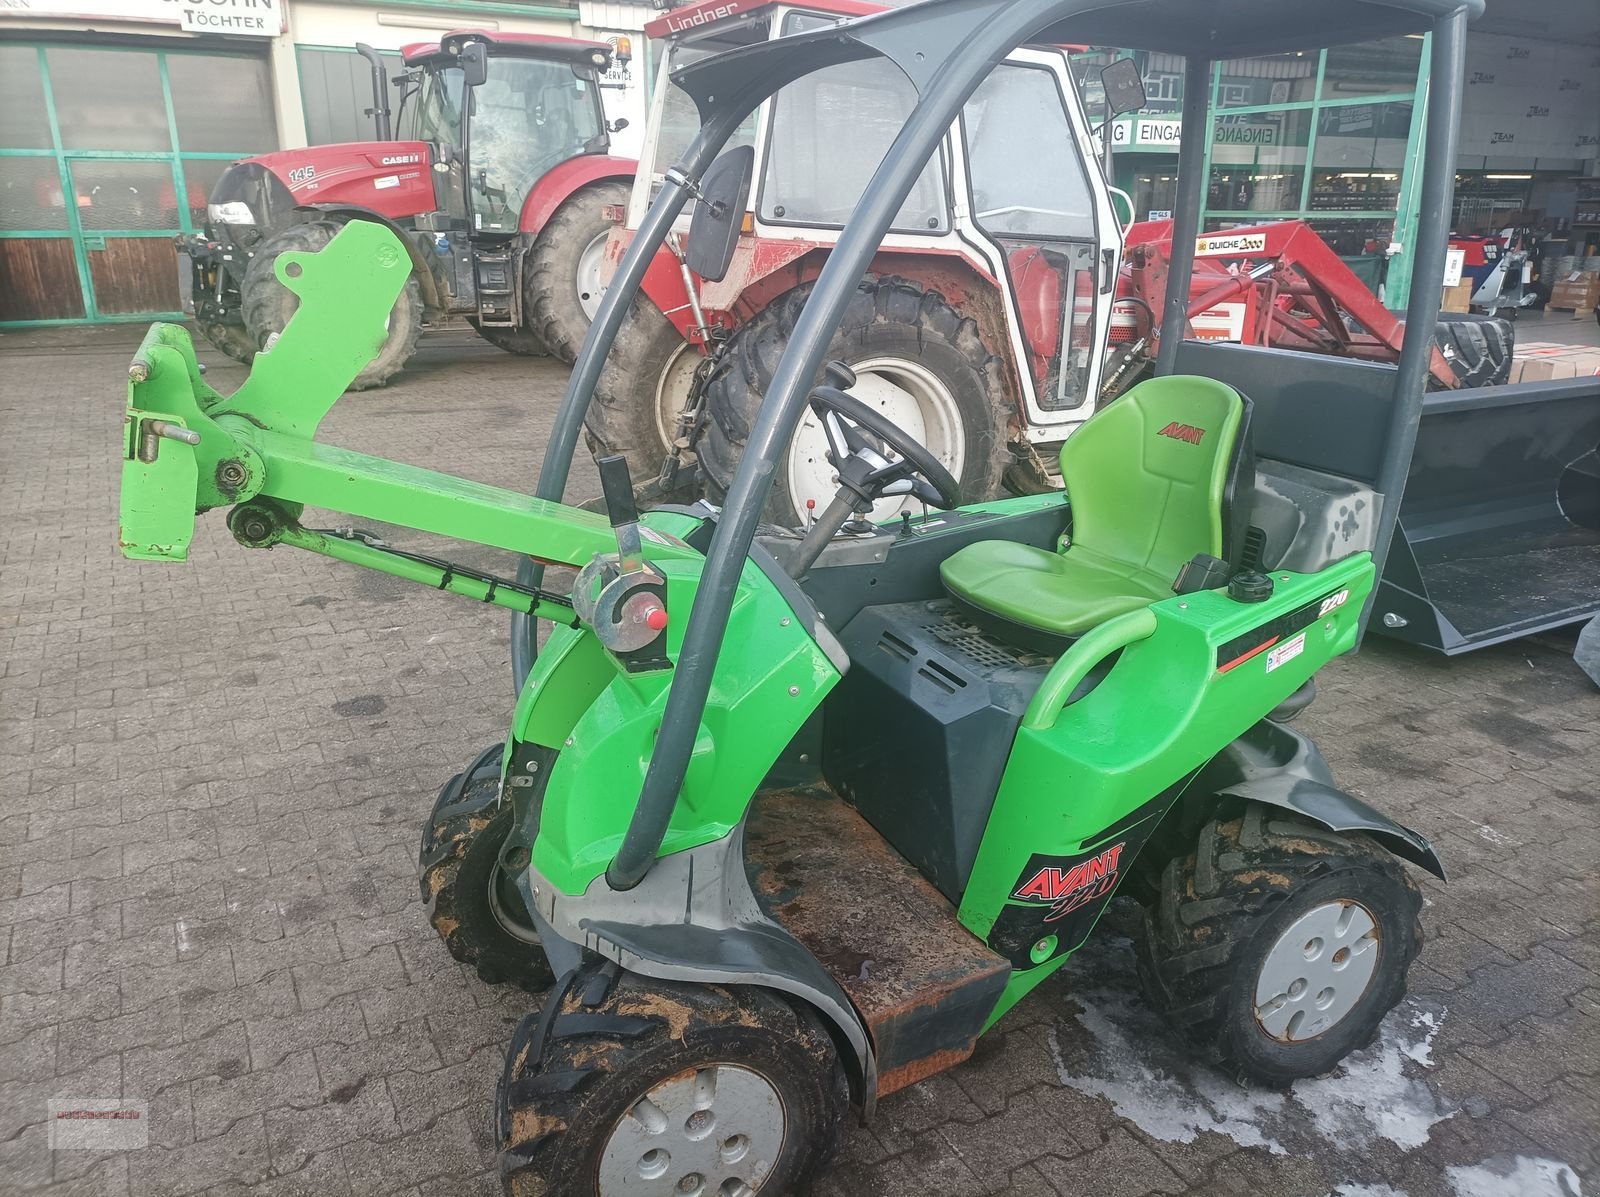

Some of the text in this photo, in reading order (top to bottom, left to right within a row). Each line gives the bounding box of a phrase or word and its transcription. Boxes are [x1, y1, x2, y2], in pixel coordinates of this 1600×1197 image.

[183, 9, 265, 29] TÖCHTER
[666, 2, 739, 33] Lindner
[604, 70, 632, 81] SERVICE
[1141, 124, 1181, 141] EINGA
[1494, 132, 1514, 140] TEAM
[382, 156, 409, 165] CASE
[289, 165, 315, 183] 145
[1208, 240, 1239, 250] QUICKE
[1239, 237, 1263, 250] 2000
[1156, 421, 1206, 446] AVANT
[1318, 589, 1349, 618] 220
[1010, 842, 1125, 900] AVANT
[1043, 870, 1118, 922] 220
